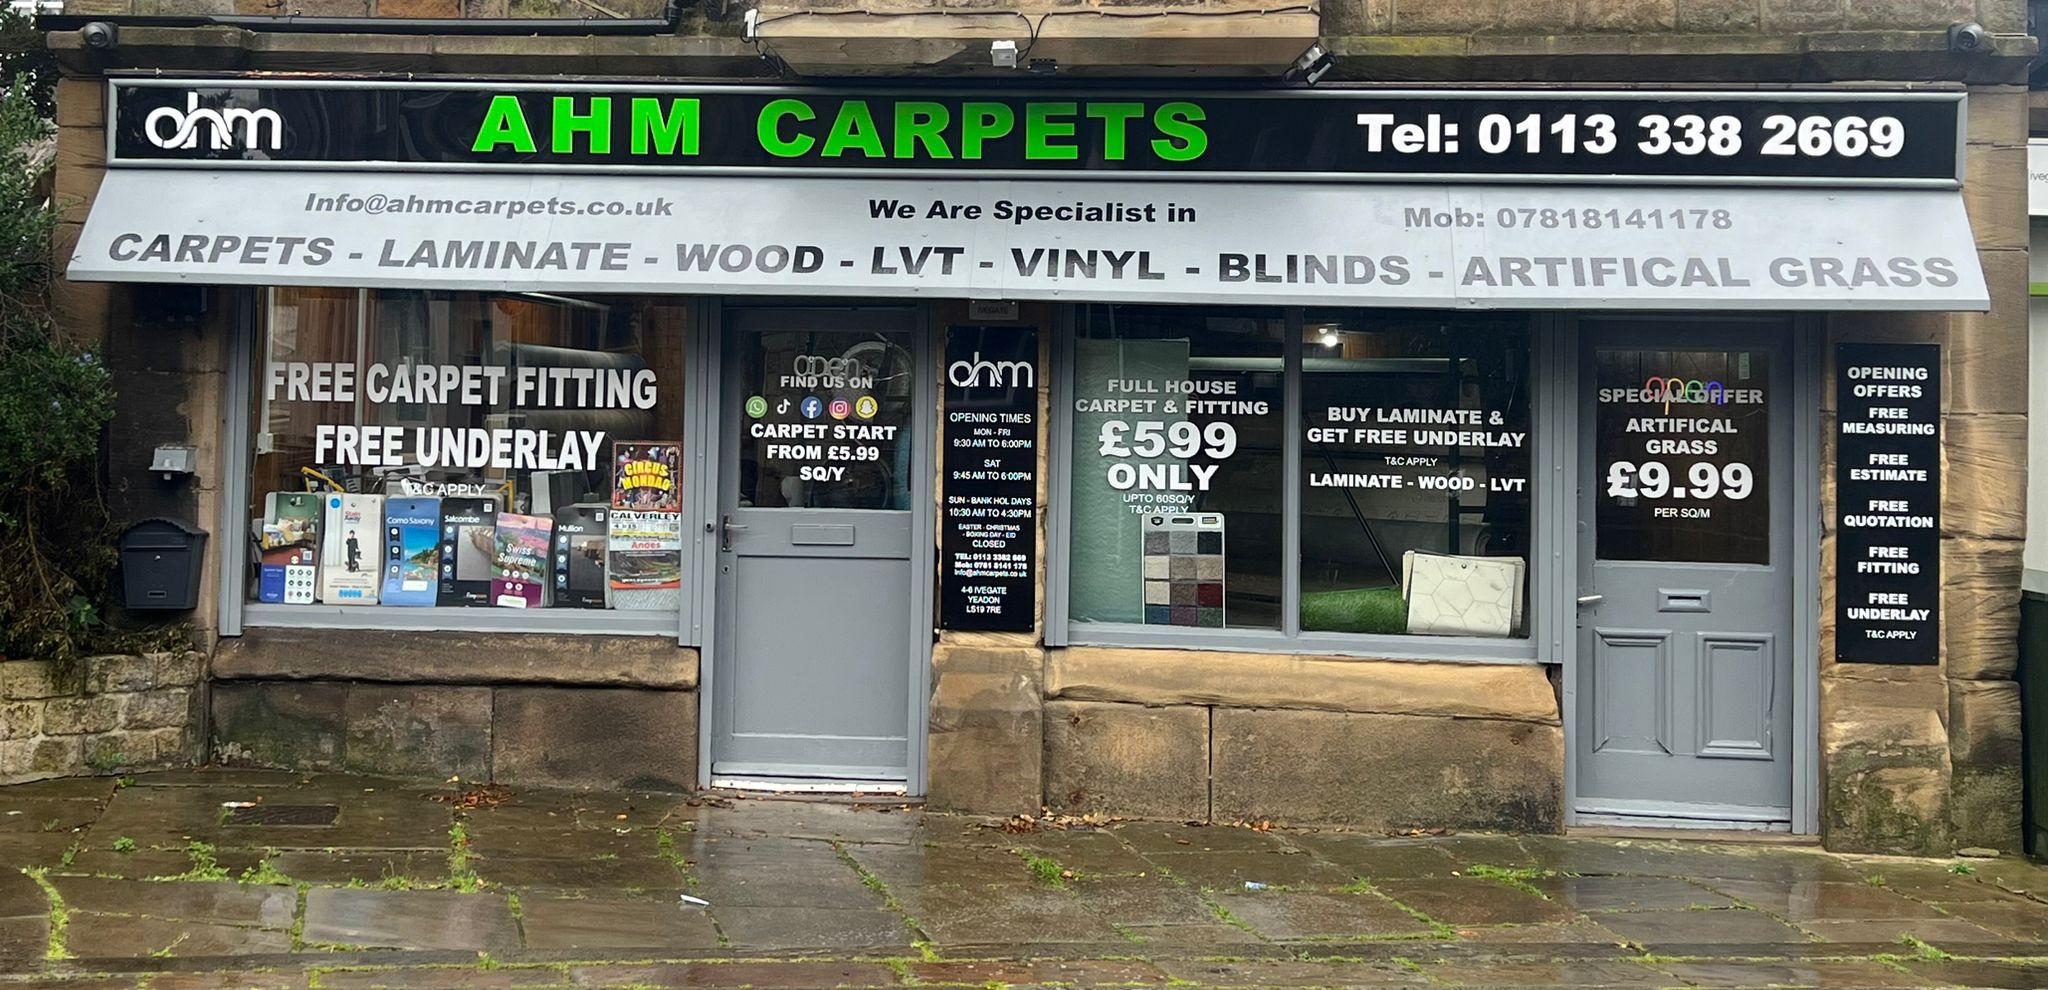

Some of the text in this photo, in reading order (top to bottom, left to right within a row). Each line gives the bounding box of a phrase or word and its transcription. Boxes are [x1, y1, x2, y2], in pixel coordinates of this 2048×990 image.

[471, 95, 1208, 162] AHM CARPETS
[1357, 113, 1905, 158] Tel: 0113 338 2669
[305, 193, 673, 220] Info@ahmcarpets.co.uk
[869, 199, 1196, 226] We Are Specialist in
[1403, 206, 1733, 231] Mob: 07818141178
[107, 232, 335, 267] CARPETS
[378, 238, 632, 271] LAMINATE
[674, 243, 825, 274] WOOD
[871, 246, 965, 275] LVT
[1011, 248, 1166, 281] VINYL
[1218, 253, 1411, 285] BLINDS
[1461, 255, 1751, 288] ARTIFICAL
[1768, 257, 1959, 289] GRASS
[1847, 366, 1929, 381] OPENING
[267, 361, 658, 409] FREE CARPET FITTING
[780, 375, 873, 389] FIND US ON
[1107, 378, 1237, 395] FULL HOUSE
[1598, 388, 1764, 404] SPECIAL OFFER
[1853, 384, 1923, 399] OFFERS
[1075, 398, 1270, 416] CARPET & FITTING
[1868, 407, 1909, 420] FREE
[950, 412, 1032, 424] OPENING TIMES
[1327, 406, 1505, 425] BUY LAMINATE &
[750, 423, 897, 440] CARPET START
[973, 428, 992, 436] MON
[998, 428, 1011, 437] FRI
[1625, 417, 1739, 434] ARTIFICAL
[1842, 422, 1936, 436] MEASURING
[953, 438, 1032, 449] 9:30 AM TO 6:00PM
[1098, 420, 1238, 459] £599
[1307, 428, 1526, 448] GET FREE UNDERLAY
[315, 424, 606, 471] FREE UNDERLAY
[766, 445, 880, 461] FROM £5.99
[1645, 439, 1719, 455] GRASS
[984, 459, 1001, 468] SAT
[1384, 456, 1438, 467] T&C APPLY
[1868, 453, 1909, 466] FREE
[624, 460, 669, 477] CIRCUS
[799, 466, 846, 482] SQ/Y
[1850, 468, 1928, 482] ESTIMATE
[622, 474, 671, 491] MONDAO
[953, 471, 971, 480] 9:45
[971, 471, 986, 480] AM
[987, 472, 1000, 481] TO
[1107, 463, 1220, 491] ONLY
[1309, 473, 1403, 489] LAMINATE
[1418, 475, 1475, 491] WOOD
[1490, 477, 1526, 492] LVT
[1606, 461, 1754, 500] £9.99
[436, 483, 486, 496] APPLY
[949, 496, 966, 504] SUN
[971, 496, 993, 505] BANK
[1122, 493, 1196, 505] UPTO 60SQ/Y
[1868, 499, 1909, 512] FREE
[611, 511, 680, 521] CALVERLEY
[949, 508, 1032, 519] 10:30 AM TO 4:30PM
[1129, 504, 1190, 514] T&C APPLY
[1654, 507, 1711, 519] PER SQ/M
[387, 516, 435, 527] Como Saxony
[444, 514, 480, 524] Salcombe
[1843, 514, 1934, 529] QUOTATION
[558, 524, 584, 533] Mullion
[958, 523, 982, 531] EASTER
[986, 524, 1021, 532] CHRISTMAS
[506, 543, 532, 556] Swiss
[972, 539, 1006, 548] CLOSED
[954, 553, 972, 561] TEL:
[973, 553, 991, 561] 0113
[1868, 546, 1909, 559] FREE
[498, 553, 537, 567] Supreme
[1857, 561, 1921, 575] FITTING
[961, 586, 1008, 594] 4-6 IVEGATE
[967, 596, 1001, 604] YEADON
[1868, 592, 1909, 606] FREE
[966, 605, 1002, 615] LS19 7RE
[1847, 607, 1931, 622] UNDERLAY
[1865, 629, 1918, 641] T&C APPLY
